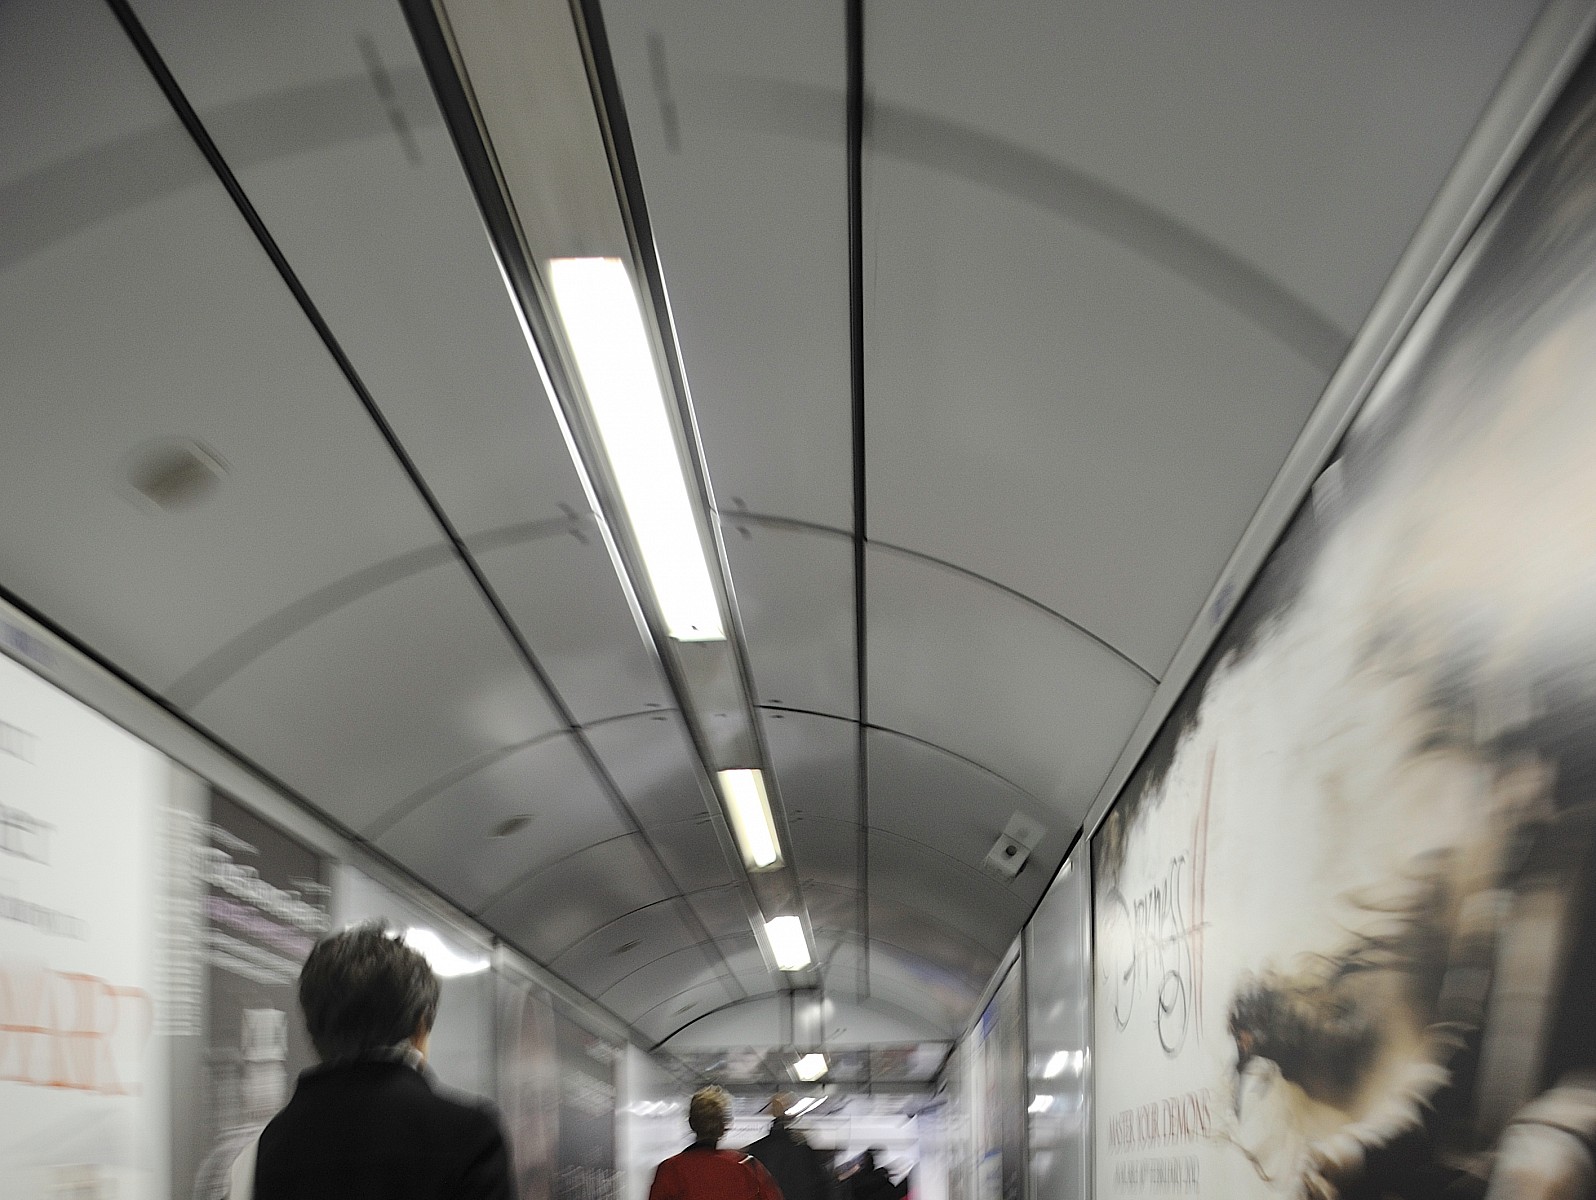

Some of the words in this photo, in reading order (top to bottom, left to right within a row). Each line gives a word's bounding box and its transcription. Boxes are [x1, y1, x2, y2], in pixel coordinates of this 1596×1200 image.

[1107, 1109, 1135, 1149] MASTER
[1136, 1102, 1160, 1148] YOUR
[1162, 1088, 1211, 1143] DEMONS
